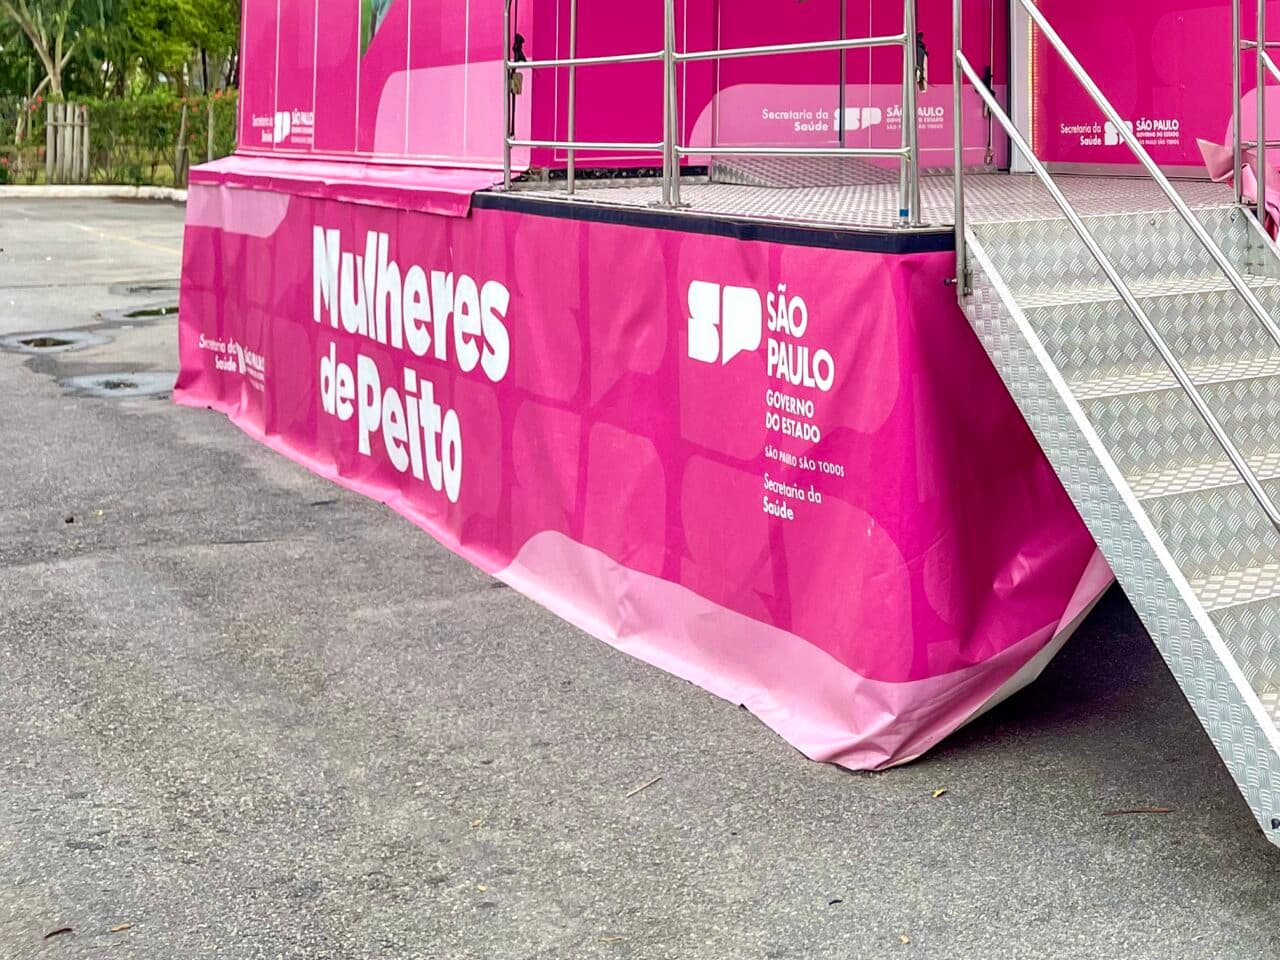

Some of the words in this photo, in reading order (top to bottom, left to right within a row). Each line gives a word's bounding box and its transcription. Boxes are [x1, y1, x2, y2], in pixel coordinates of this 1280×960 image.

[762, 108, 812, 121] Secretaria
[815, 108, 829, 120] da
[794, 120, 829, 132] Saúde
[917, 106, 944, 117] AULO
[1136, 117, 1152, 131] SÃO
[1153, 120, 1179, 131] PAULO
[1060, 122, 1091, 134] Secretaria
[1092, 121, 1102, 133] da
[1080, 135, 1102, 146] Saúde
[312, 225, 511, 382] Mulheres
[767, 283, 808, 338] SÃO
[767, 338, 835, 391] PAULO
[766, 389, 815, 419] GOVERNO
[320, 343, 355, 422] de
[356, 353, 463, 503] Peito
[765, 412, 780, 431] DO
[781, 419, 821, 444] ESTADO
[765, 445, 778, 460] SÃO
[799, 456, 816, 472] SÃO
[818, 460, 845, 478] TODOS
[763, 472, 805, 500] Secretaria
[807, 483, 822, 504] da
[762, 496, 795, 521] Saúde
